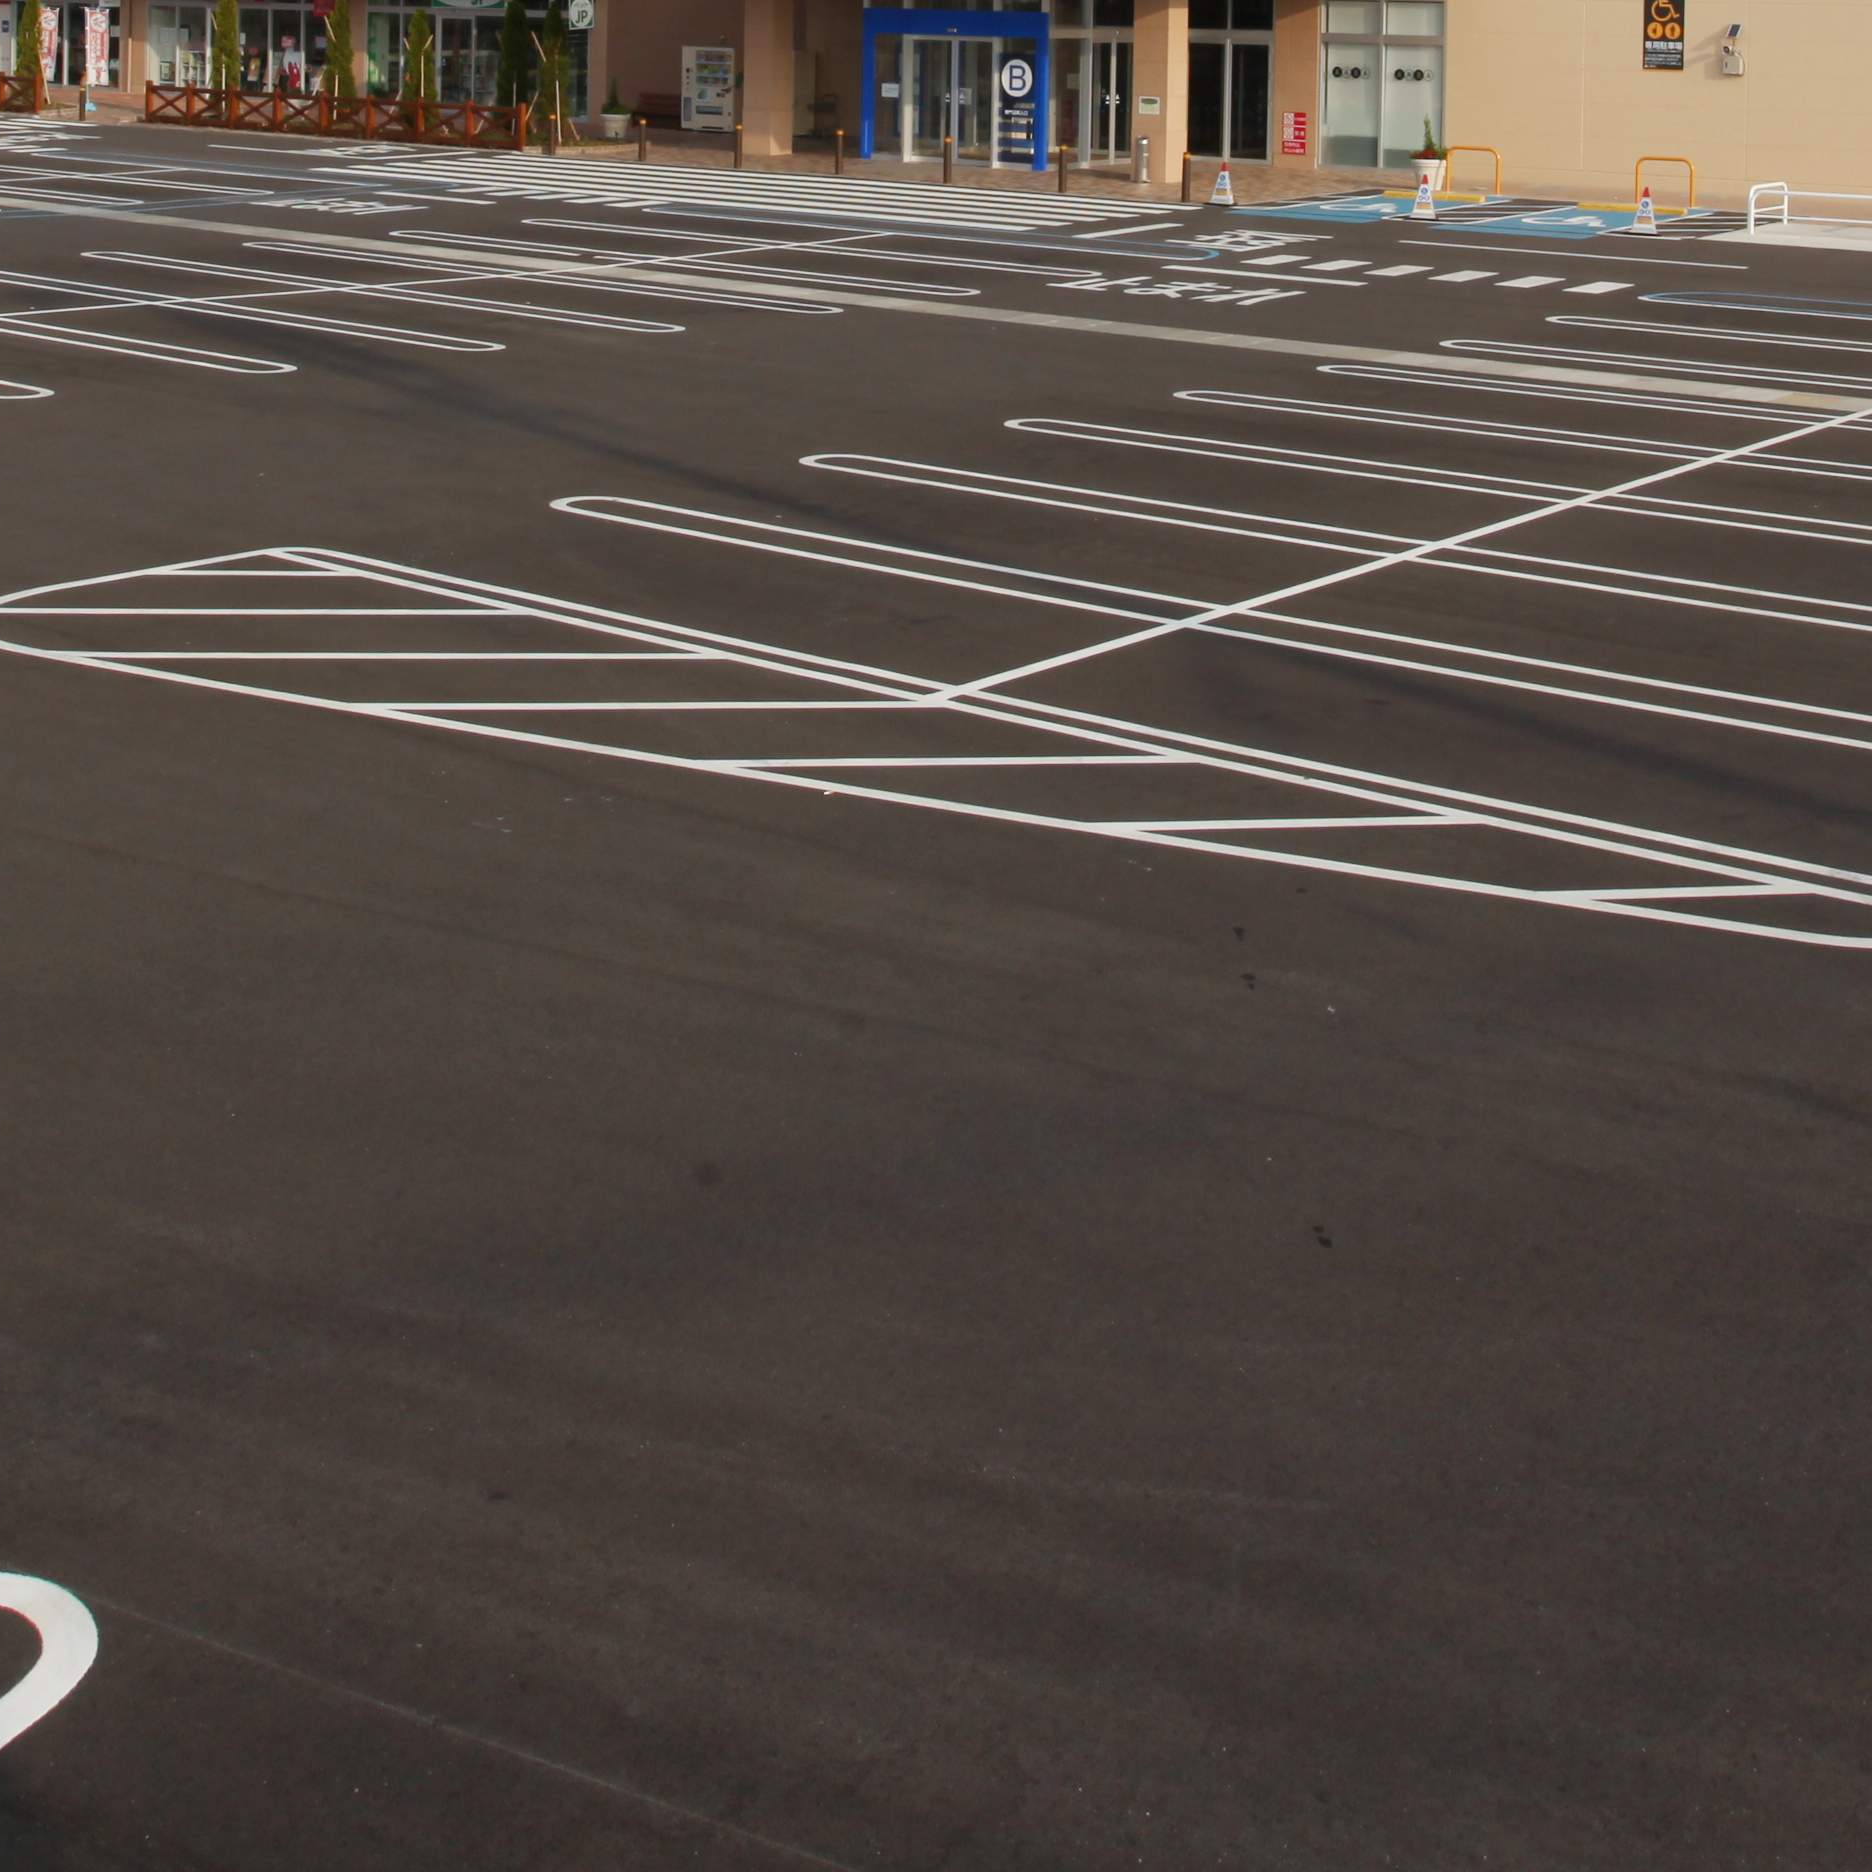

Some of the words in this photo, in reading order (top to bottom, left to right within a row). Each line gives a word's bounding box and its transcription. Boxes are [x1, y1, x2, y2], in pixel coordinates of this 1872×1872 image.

[575, 10, 588, 24] JP
[1009, 65, 1026, 91] B
[1046, 275, 1306, 306] 止まれ
